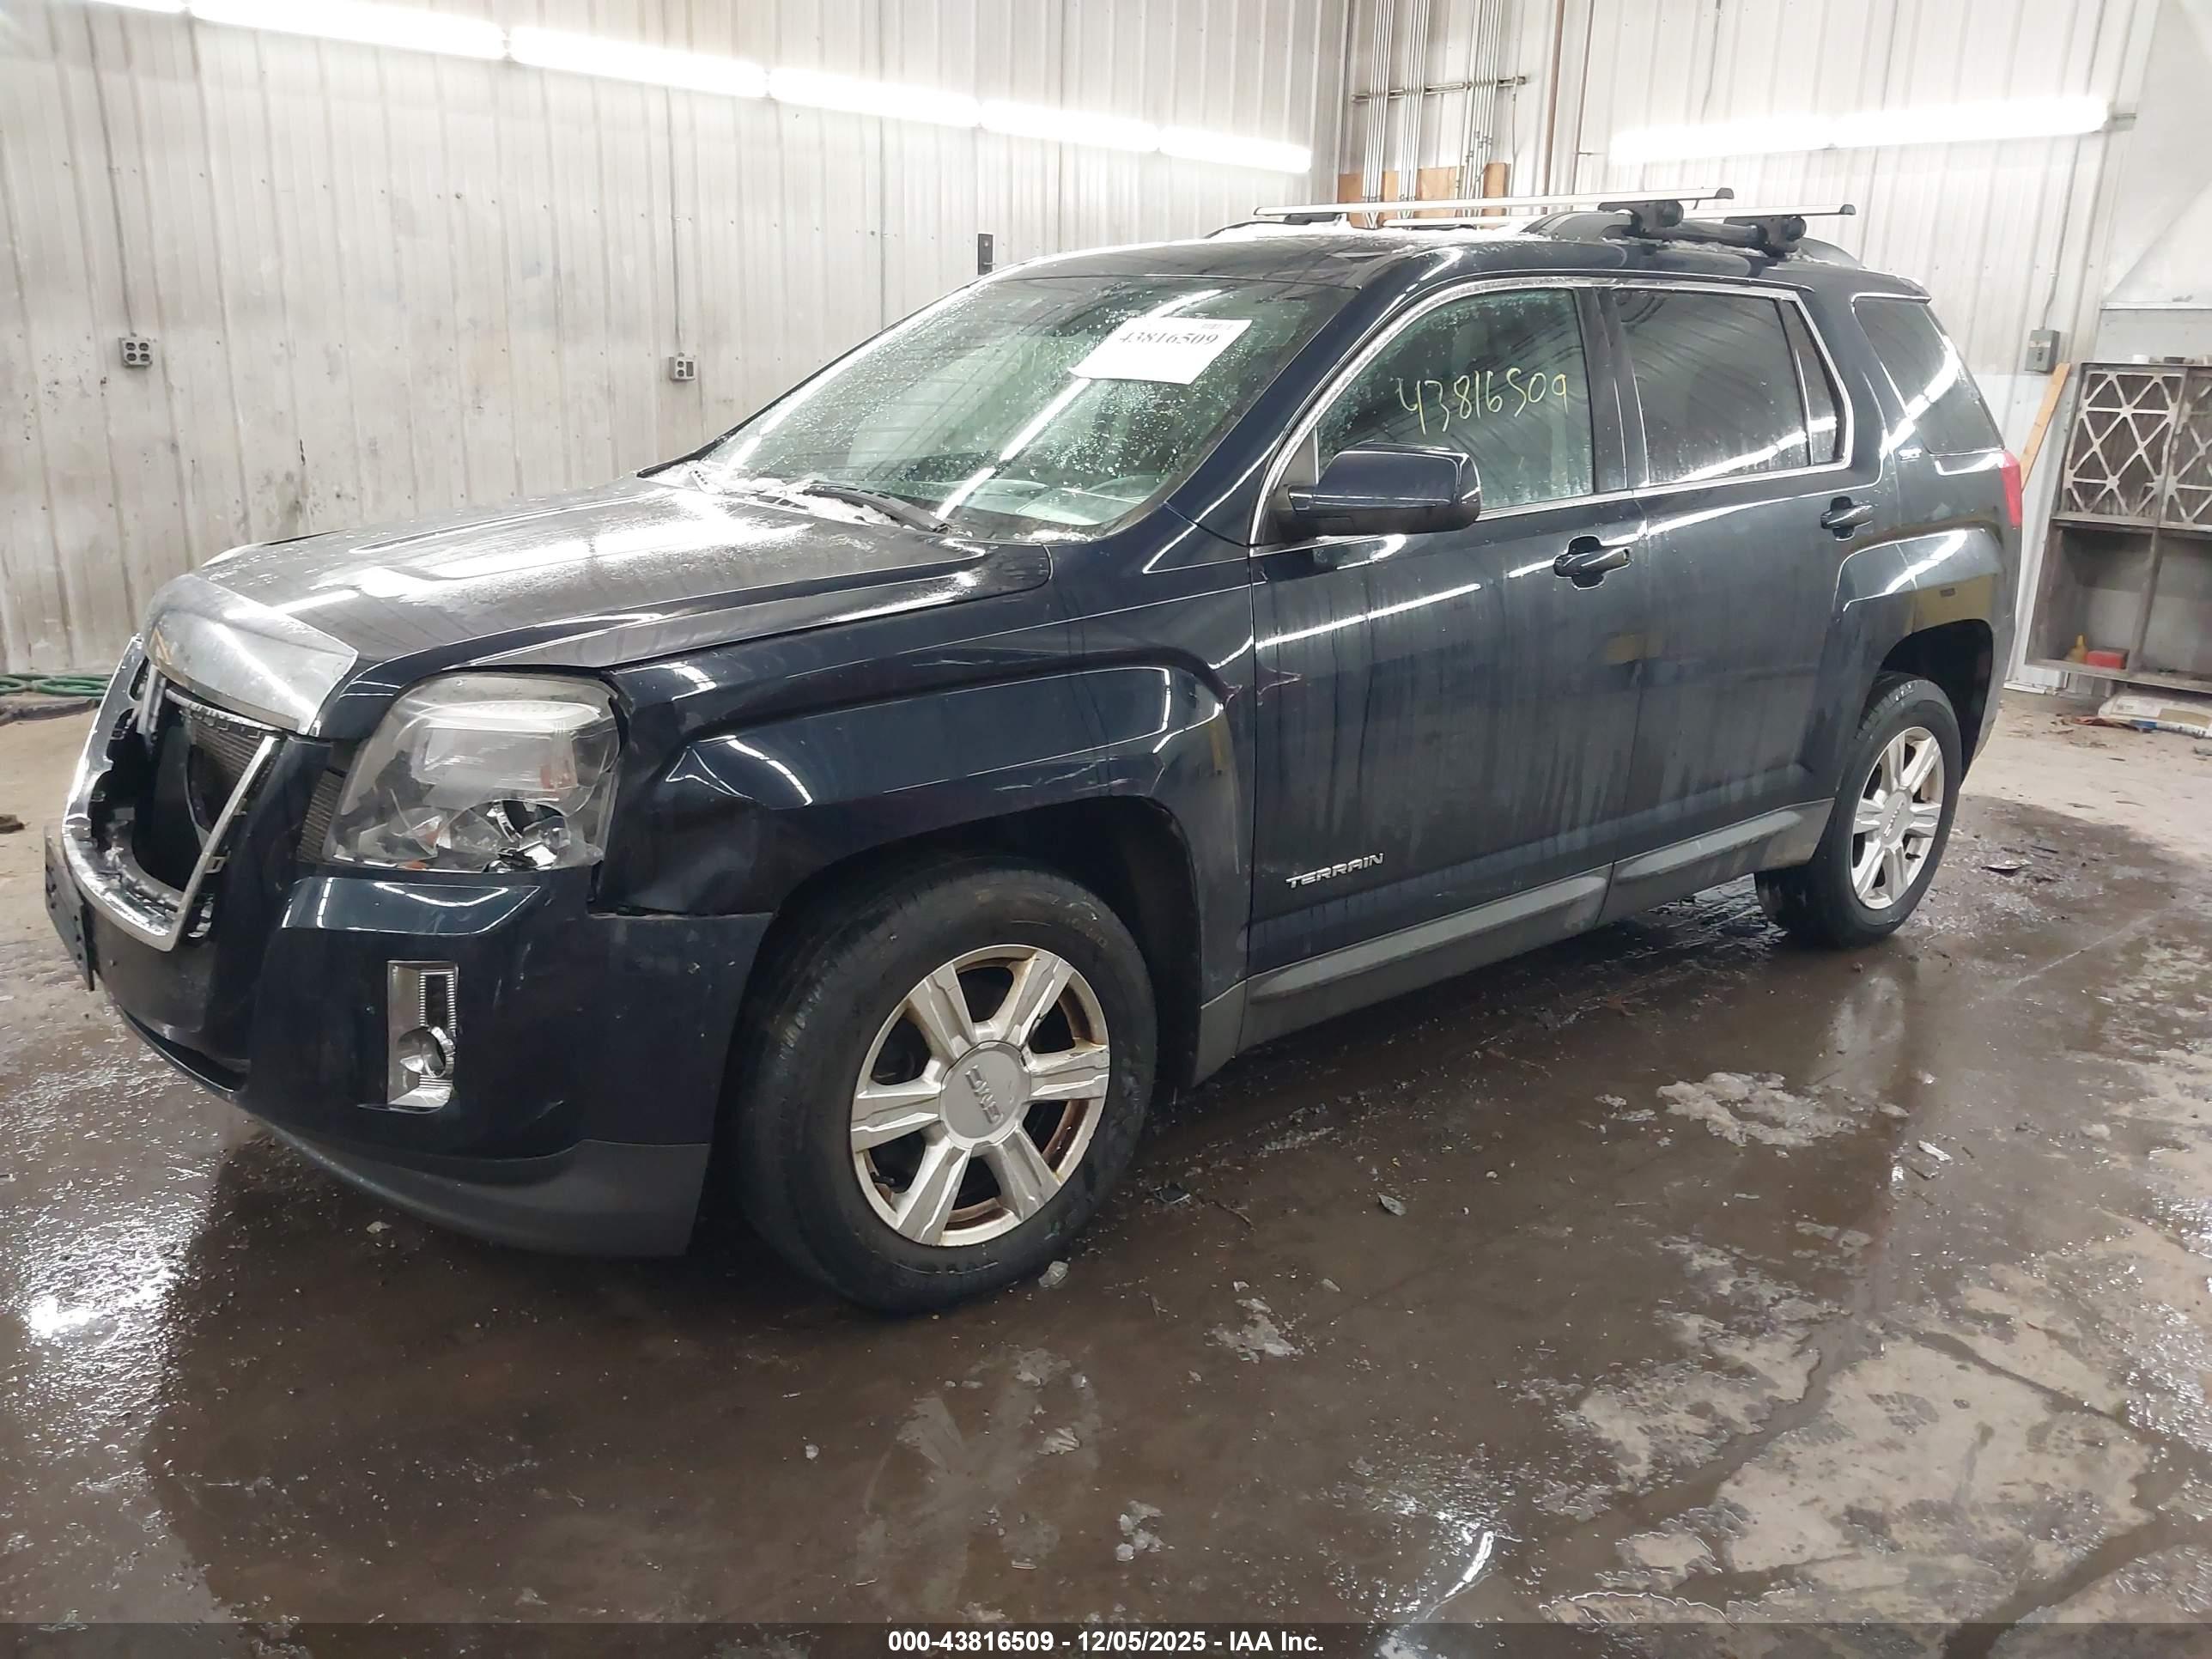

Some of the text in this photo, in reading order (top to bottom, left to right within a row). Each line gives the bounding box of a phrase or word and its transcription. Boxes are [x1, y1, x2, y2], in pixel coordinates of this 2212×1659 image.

[1119, 331, 1219, 345] 43816509
[1395, 368, 1569, 435] 43816509
[1285, 852, 1384, 889] TERRAIN
[964, 1064, 1004, 1126] GMC
